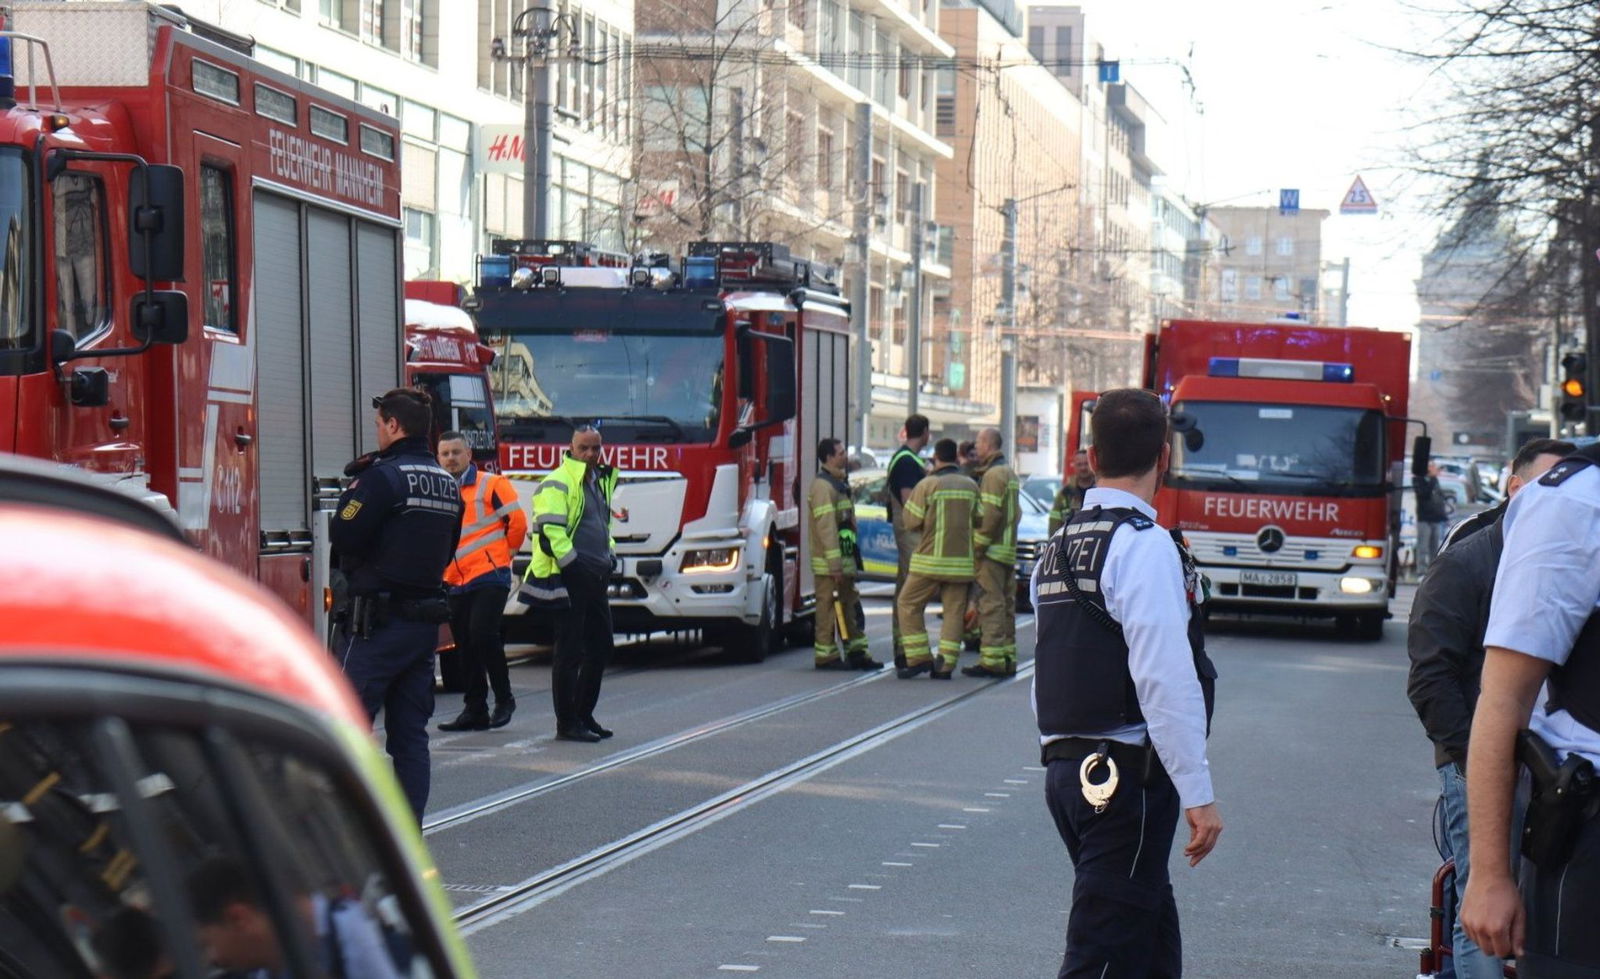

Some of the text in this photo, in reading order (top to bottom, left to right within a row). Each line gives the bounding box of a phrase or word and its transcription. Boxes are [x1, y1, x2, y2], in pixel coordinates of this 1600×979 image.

[269, 128, 384, 208] FEUERWEHR MANNHEIM
[1204, 497, 1339, 522] FEUERWEHR
